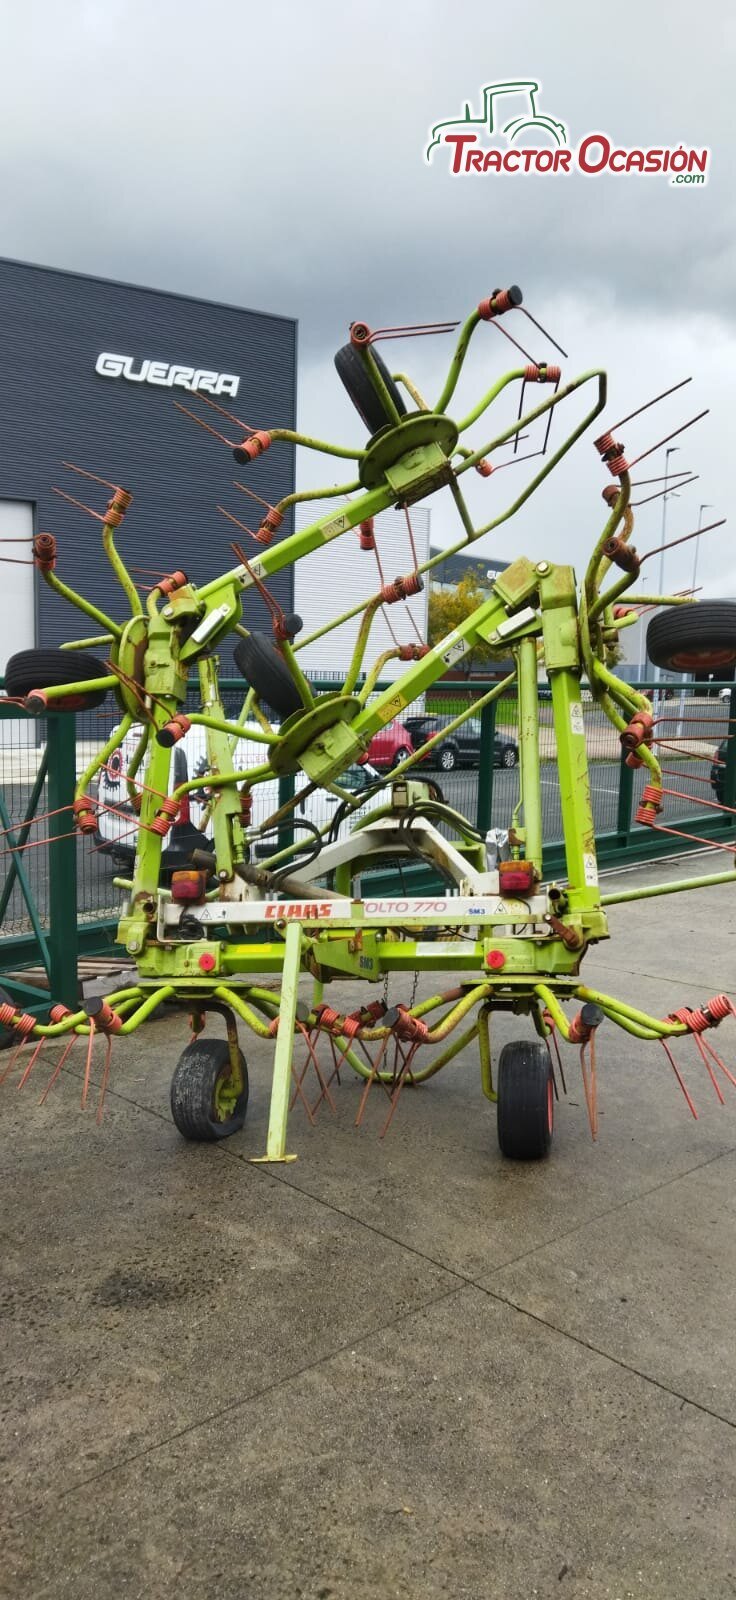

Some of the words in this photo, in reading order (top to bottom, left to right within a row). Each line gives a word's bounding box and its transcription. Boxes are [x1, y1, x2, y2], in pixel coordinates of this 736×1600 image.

[95, 352, 241, 397] GUERRA
[265, 903, 332, 919] CLAAS
[364, 902, 408, 913] OLTO
[412, 902, 447, 913] 770
[360, 956, 373, 970] SM3
